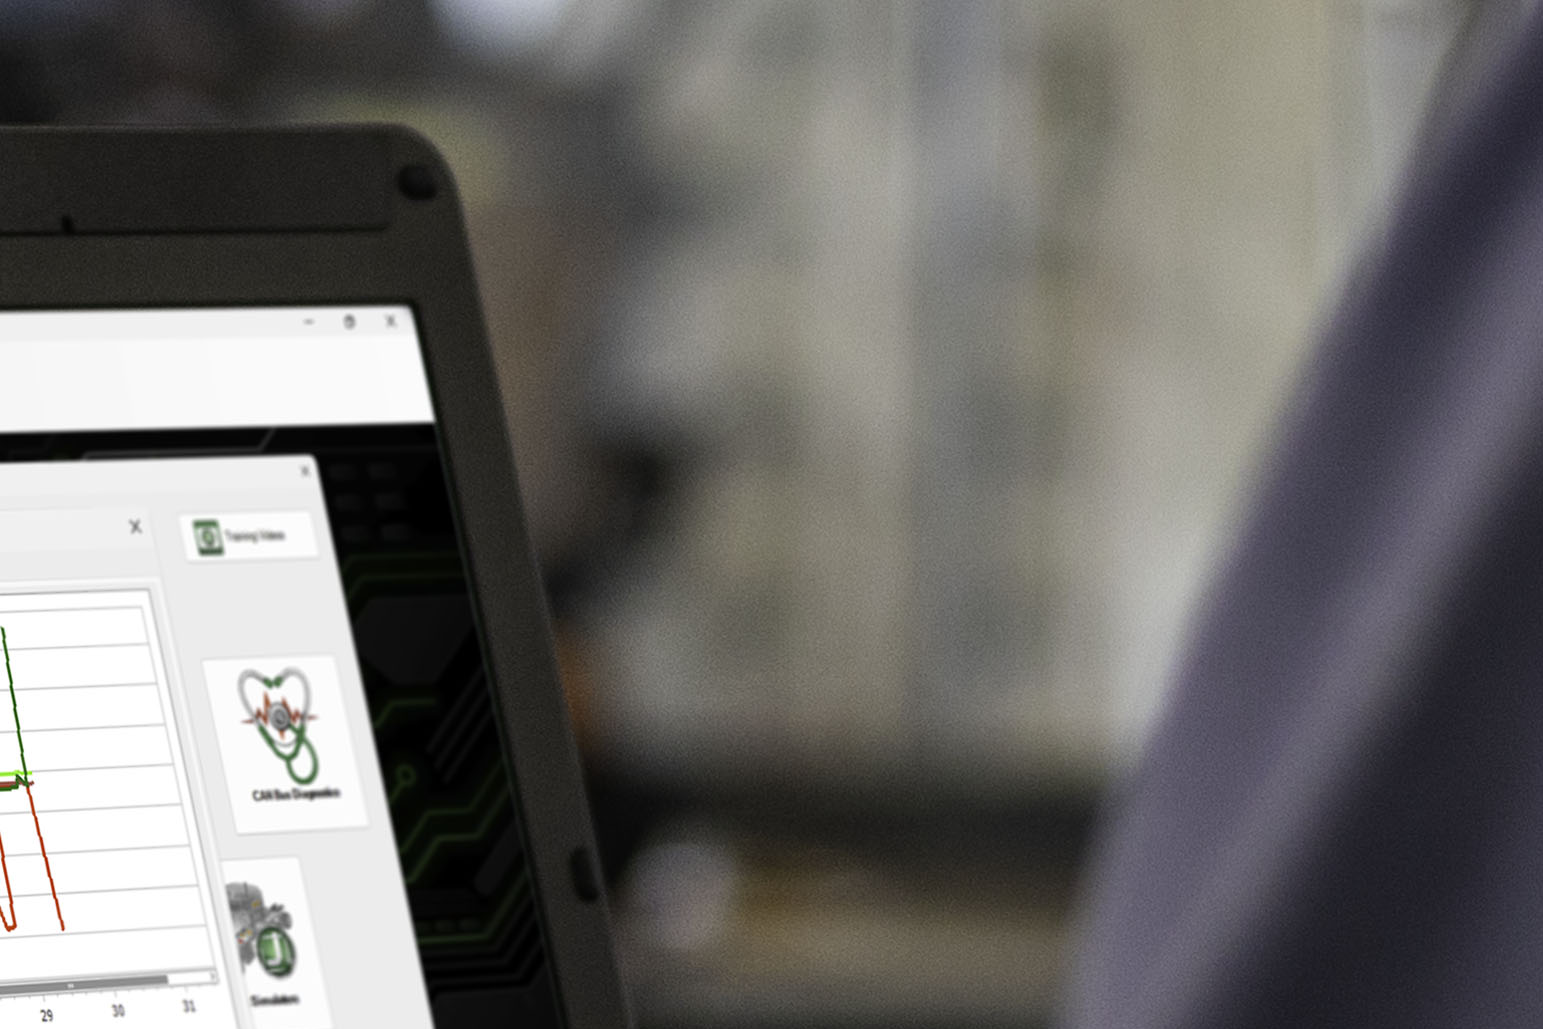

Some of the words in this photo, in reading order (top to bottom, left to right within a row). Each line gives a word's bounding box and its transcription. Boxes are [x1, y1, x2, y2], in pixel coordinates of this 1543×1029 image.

[252, 789, 273, 802] CAN
[39, 1008, 55, 1024] 29
[112, 1003, 126, 1018] 30
[183, 999, 197, 1014] 31
